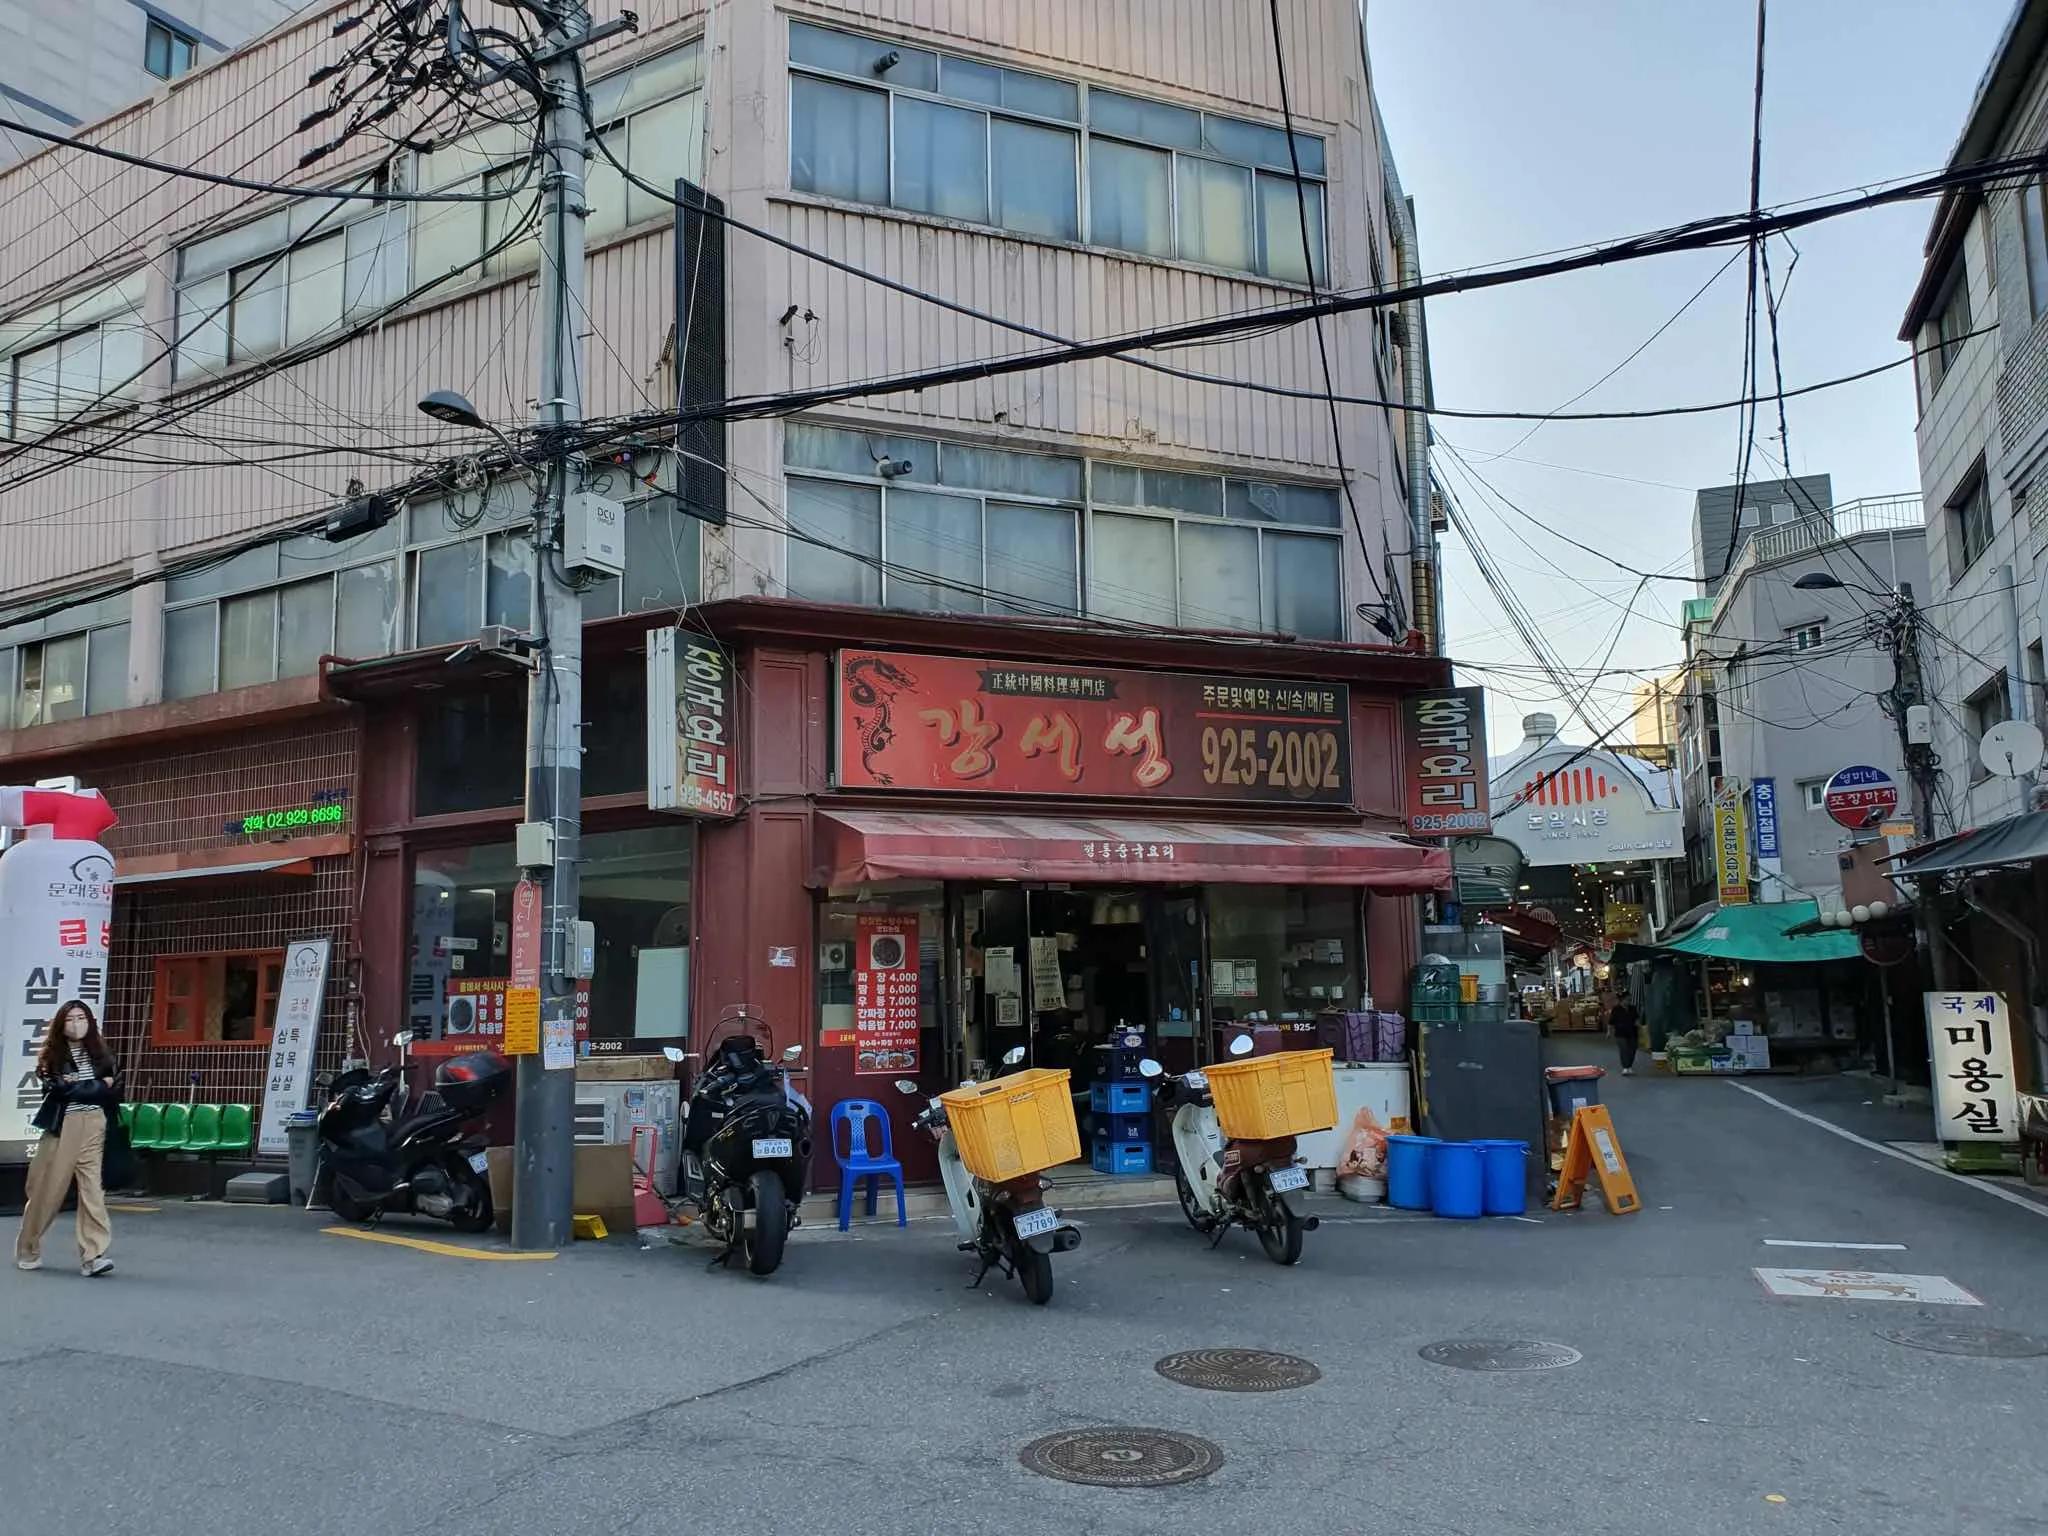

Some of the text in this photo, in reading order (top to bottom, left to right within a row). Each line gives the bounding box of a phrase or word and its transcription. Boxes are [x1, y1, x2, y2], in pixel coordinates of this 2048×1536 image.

[598, 507, 615, 522] DCU
[685, 643, 727, 786] 중국요리
[1201, 726, 1340, 788] 925-2002
[679, 786, 736, 813] 925-4567
[243, 815, 264, 834] 전화
[1413, 812, 1488, 831] 925-2002
[1527, 808, 1609, 831] 돈암시장
[1083, 842, 1174, 860] 정통중국요리
[1721, 799, 1740, 886] 색소폰연습실
[1940, 995, 1996, 1015] 국제
[1943, 1019, 2005, 1134] 미용실
